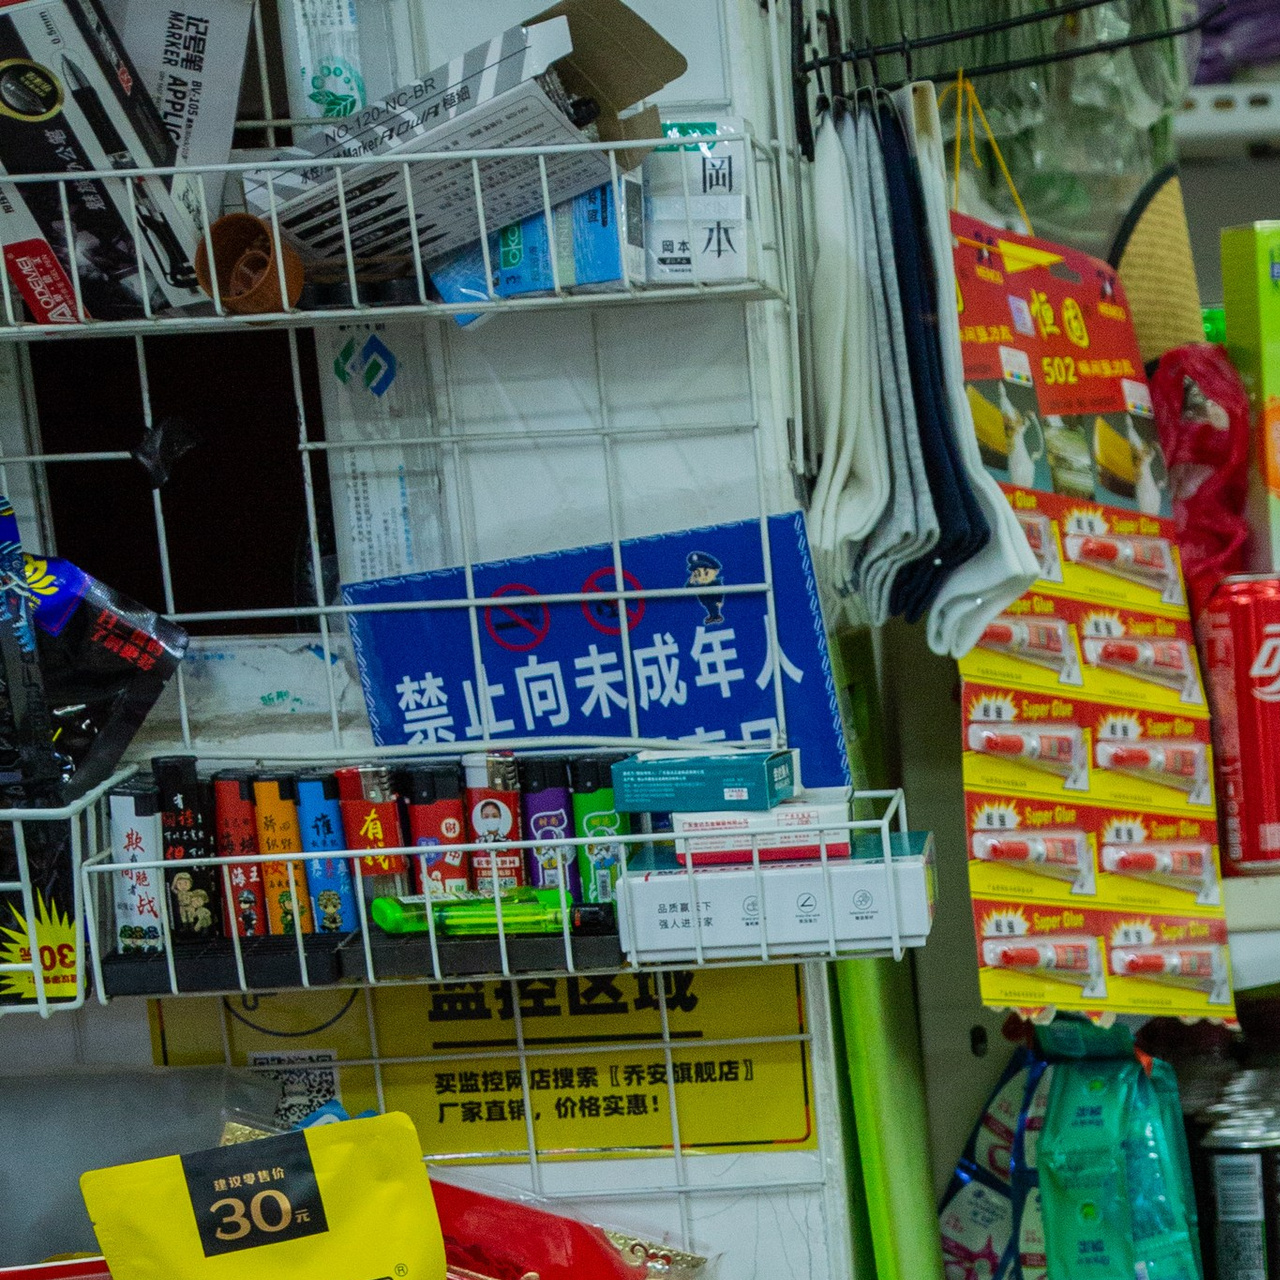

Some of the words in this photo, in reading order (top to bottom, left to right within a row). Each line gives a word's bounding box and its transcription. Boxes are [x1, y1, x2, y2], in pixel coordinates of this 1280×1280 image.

[162, 10, 185, 67] MARKER
[188, 81, 204, 117] BV-105
[324, 77, 437, 147] NO-120-NC-BR
[1042, 357, 1078, 385] 502
[1013, 595, 1032, 611] uper
[396, 614, 805, 747] 禁止向未成年人
[657, 901, 712, 914] 品质赢下
[213, 1166, 285, 1192] 建议零售价
[209, 1188, 293, 1242] 30
